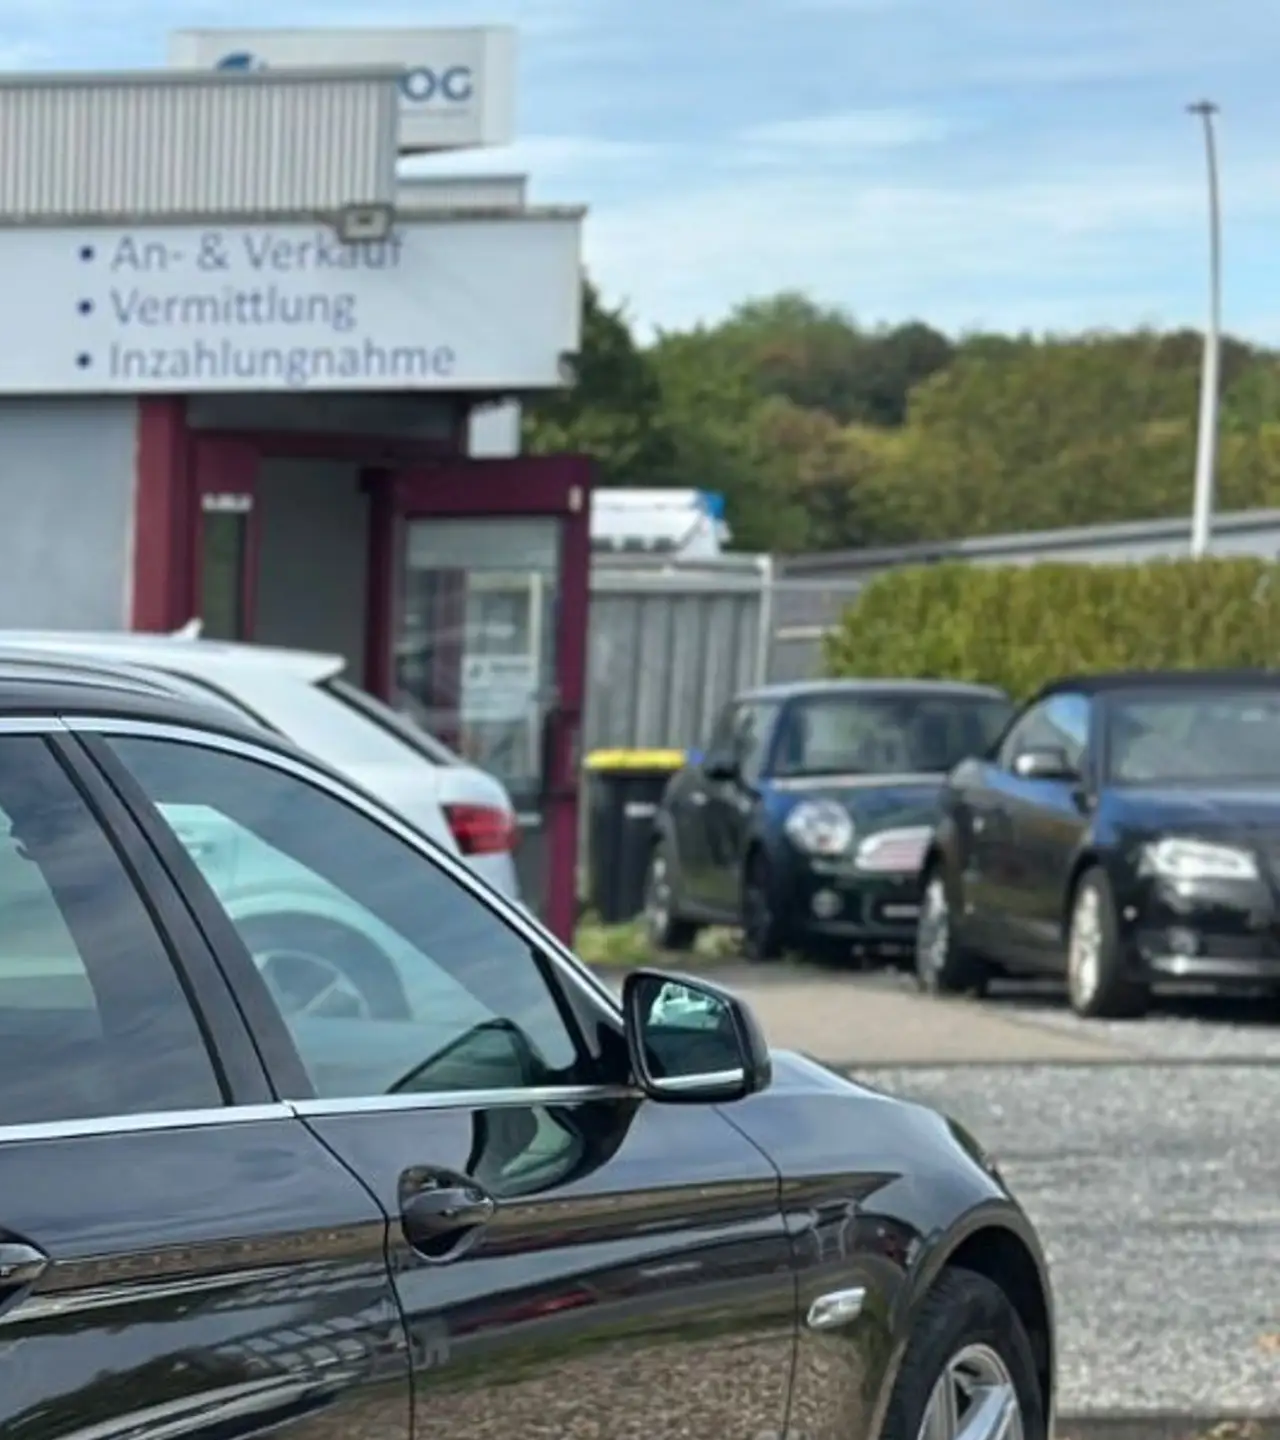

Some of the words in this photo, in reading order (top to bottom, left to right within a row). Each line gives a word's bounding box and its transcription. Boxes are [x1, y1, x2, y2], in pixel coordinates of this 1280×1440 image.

[111, 234, 184, 272] An-
[196, 231, 230, 272] &
[243, 230, 407, 271] Verkauf
[110, 285, 357, 332] Vermittlung
[110, 338, 455, 387] Inzahlungnahme
